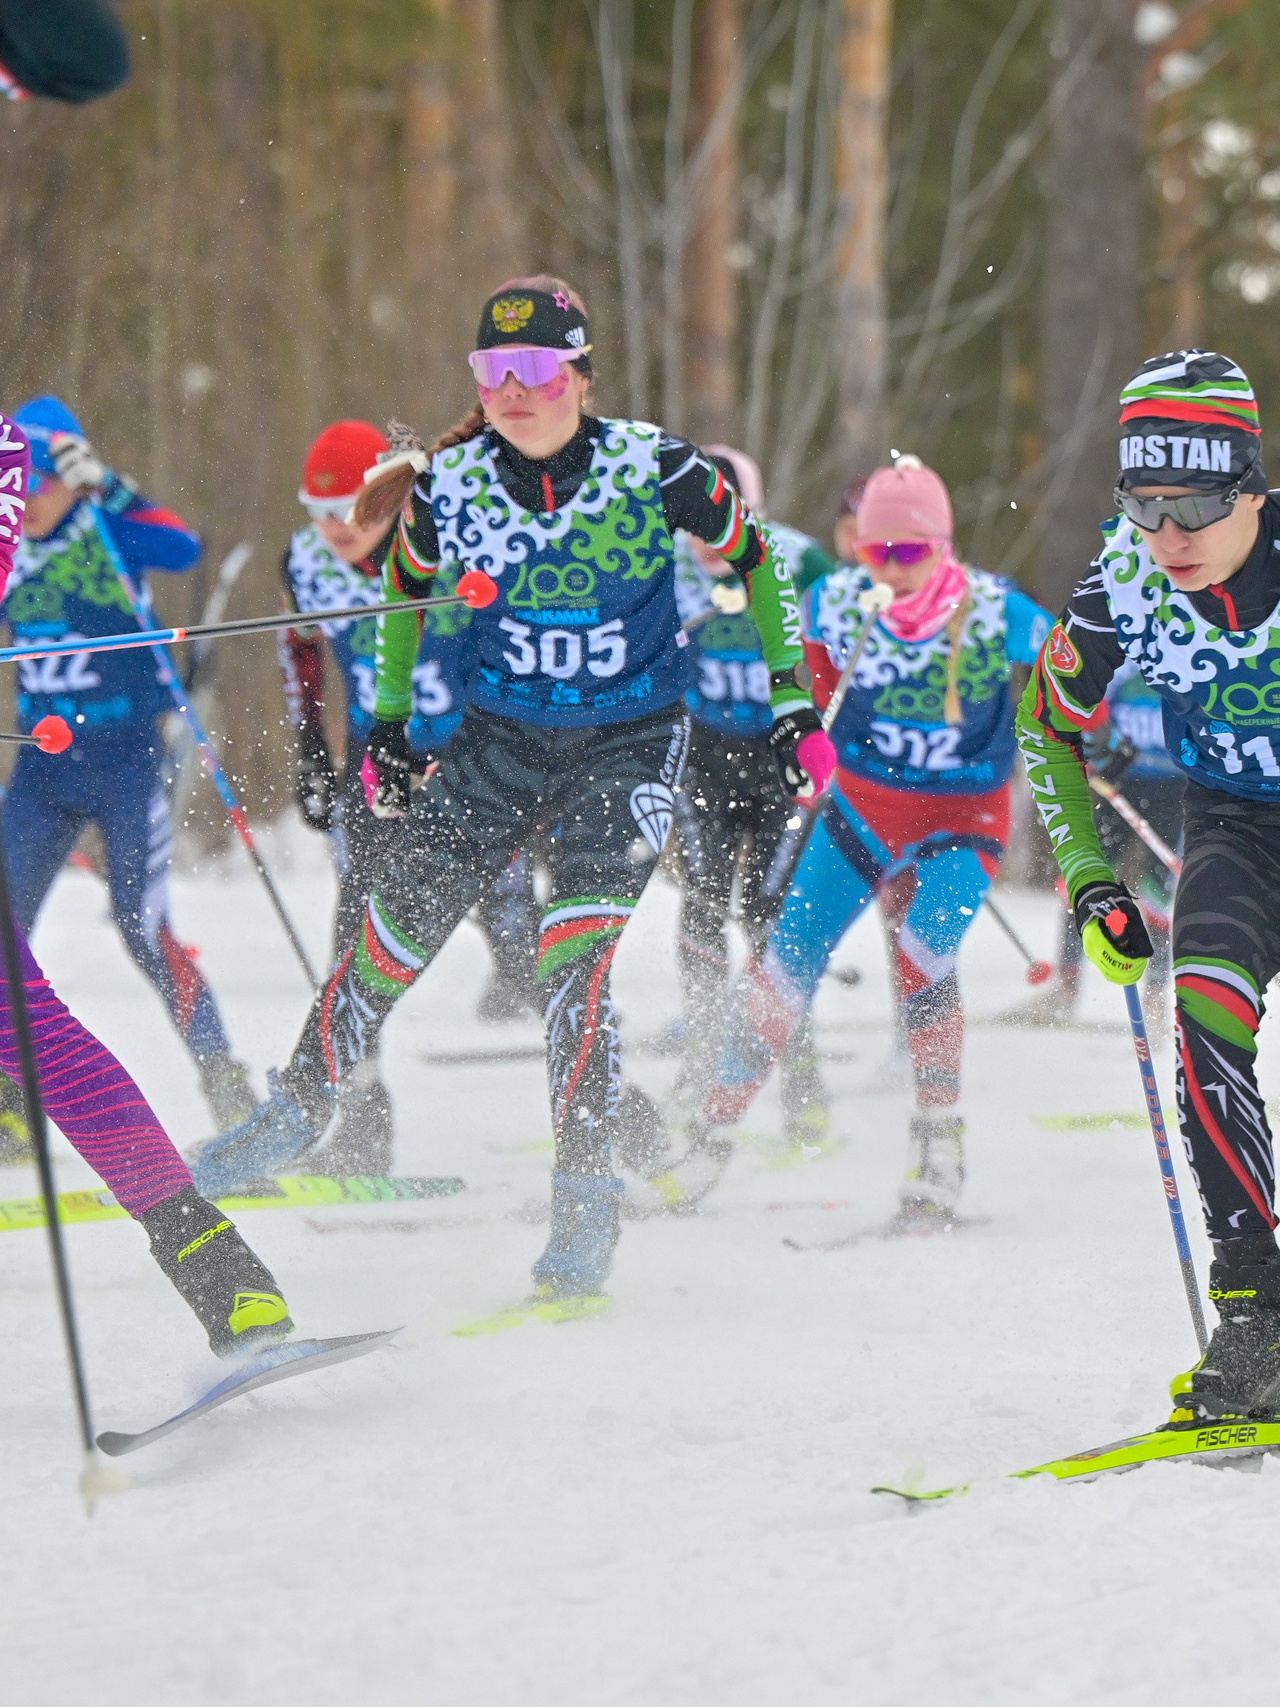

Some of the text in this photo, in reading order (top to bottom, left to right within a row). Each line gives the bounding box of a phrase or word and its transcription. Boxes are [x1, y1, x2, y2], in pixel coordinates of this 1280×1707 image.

[1119, 434, 1231, 473] ARSTAN
[499, 616, 627, 679] 305
[351, 660, 454, 716] 33
[1018, 726, 1075, 854] KAZAN
[177, 1219, 236, 1264] FISCHER
[1195, 1426, 1258, 1449] FISCHER
